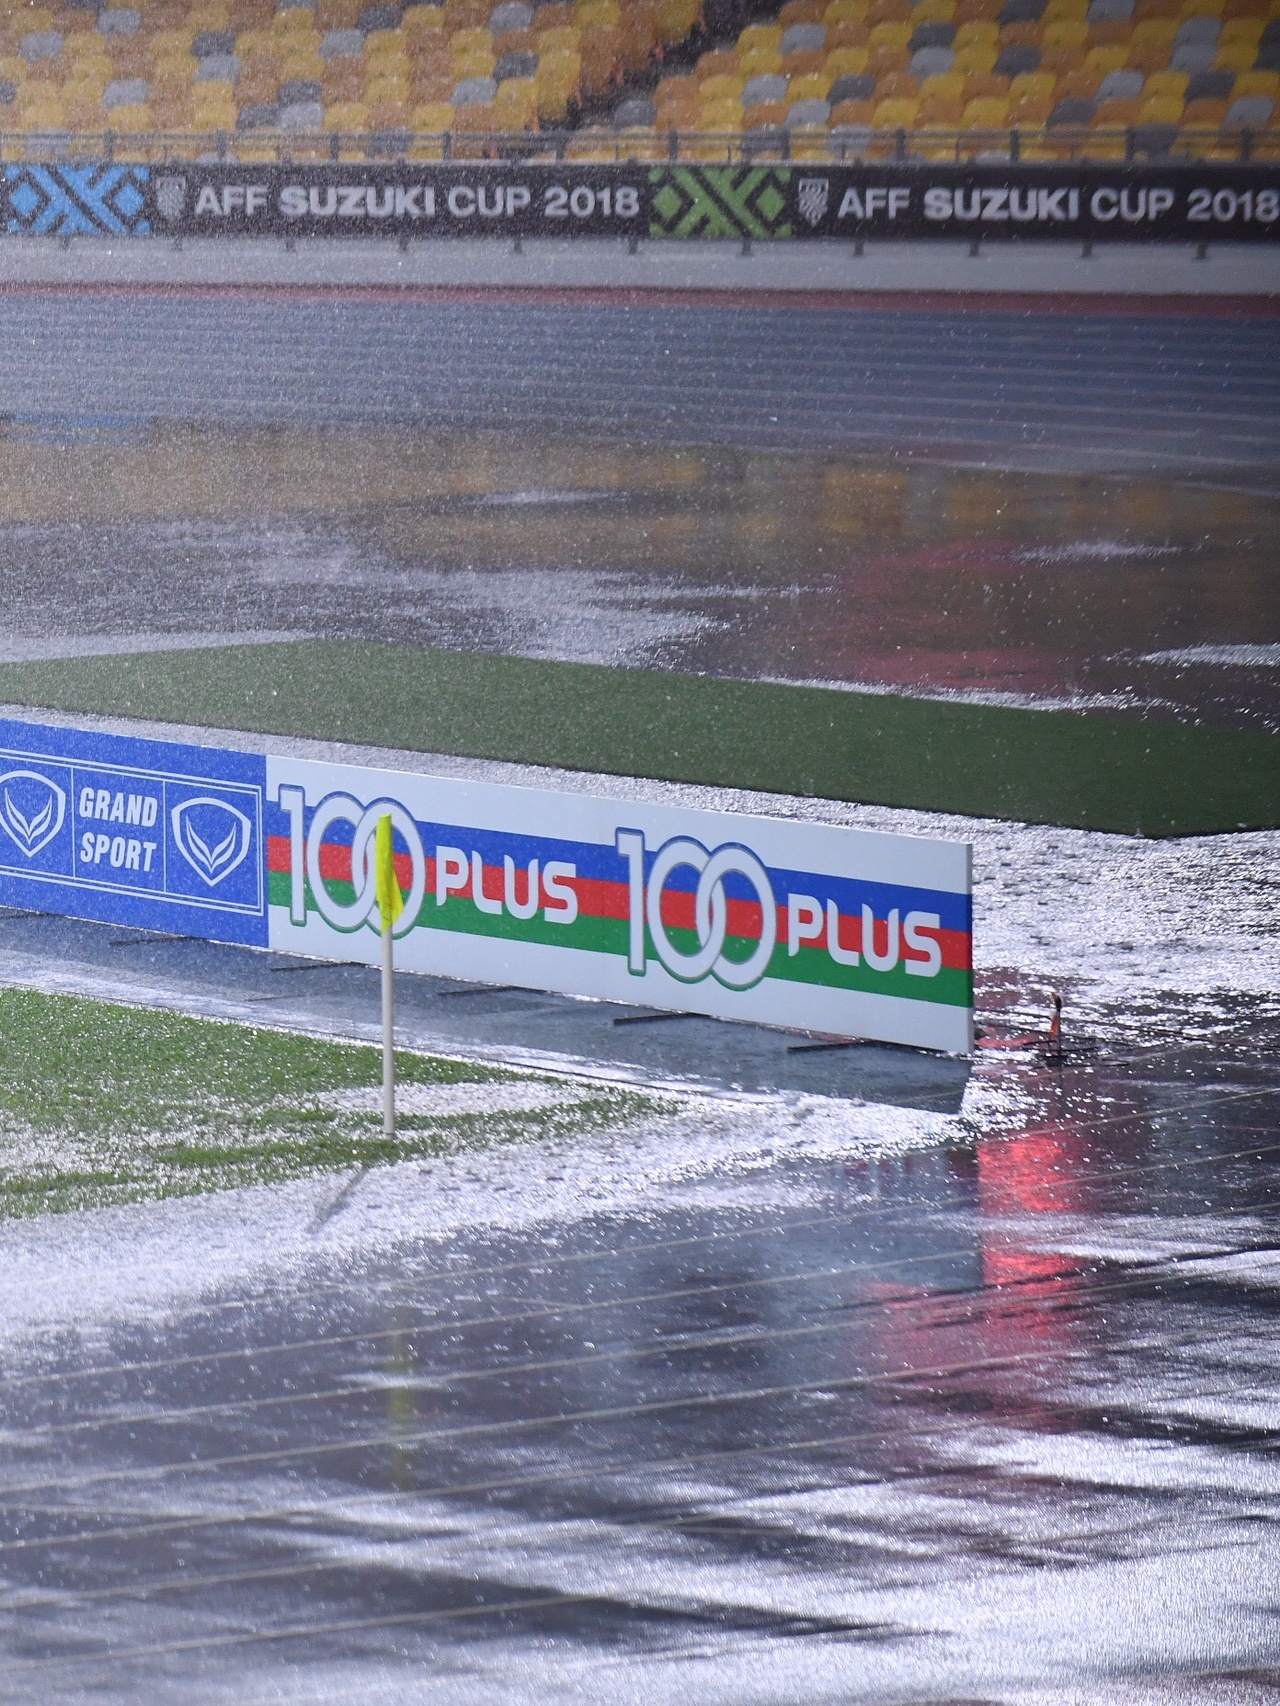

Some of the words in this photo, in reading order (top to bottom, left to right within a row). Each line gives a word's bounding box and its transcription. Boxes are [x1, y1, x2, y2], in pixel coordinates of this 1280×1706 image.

[195, 185, 269, 216] AFF
[279, 185, 435, 217] SUZUKI
[447, 185, 531, 217] CUP
[544, 185, 640, 217] 2018
[837, 187, 911, 219] AFF
[923, 187, 1080, 221] SUZUKI
[1091, 187, 1174, 221] CUP
[1186, 187, 1280, 222] 2018
[79, 786, 159, 828] GRAND
[80, 831, 158, 873] SPORT
[278, 783, 428, 940] 100
[435, 844, 580, 925] PLUS
[615, 826, 778, 992] 100
[787, 892, 943, 978] PLUS
